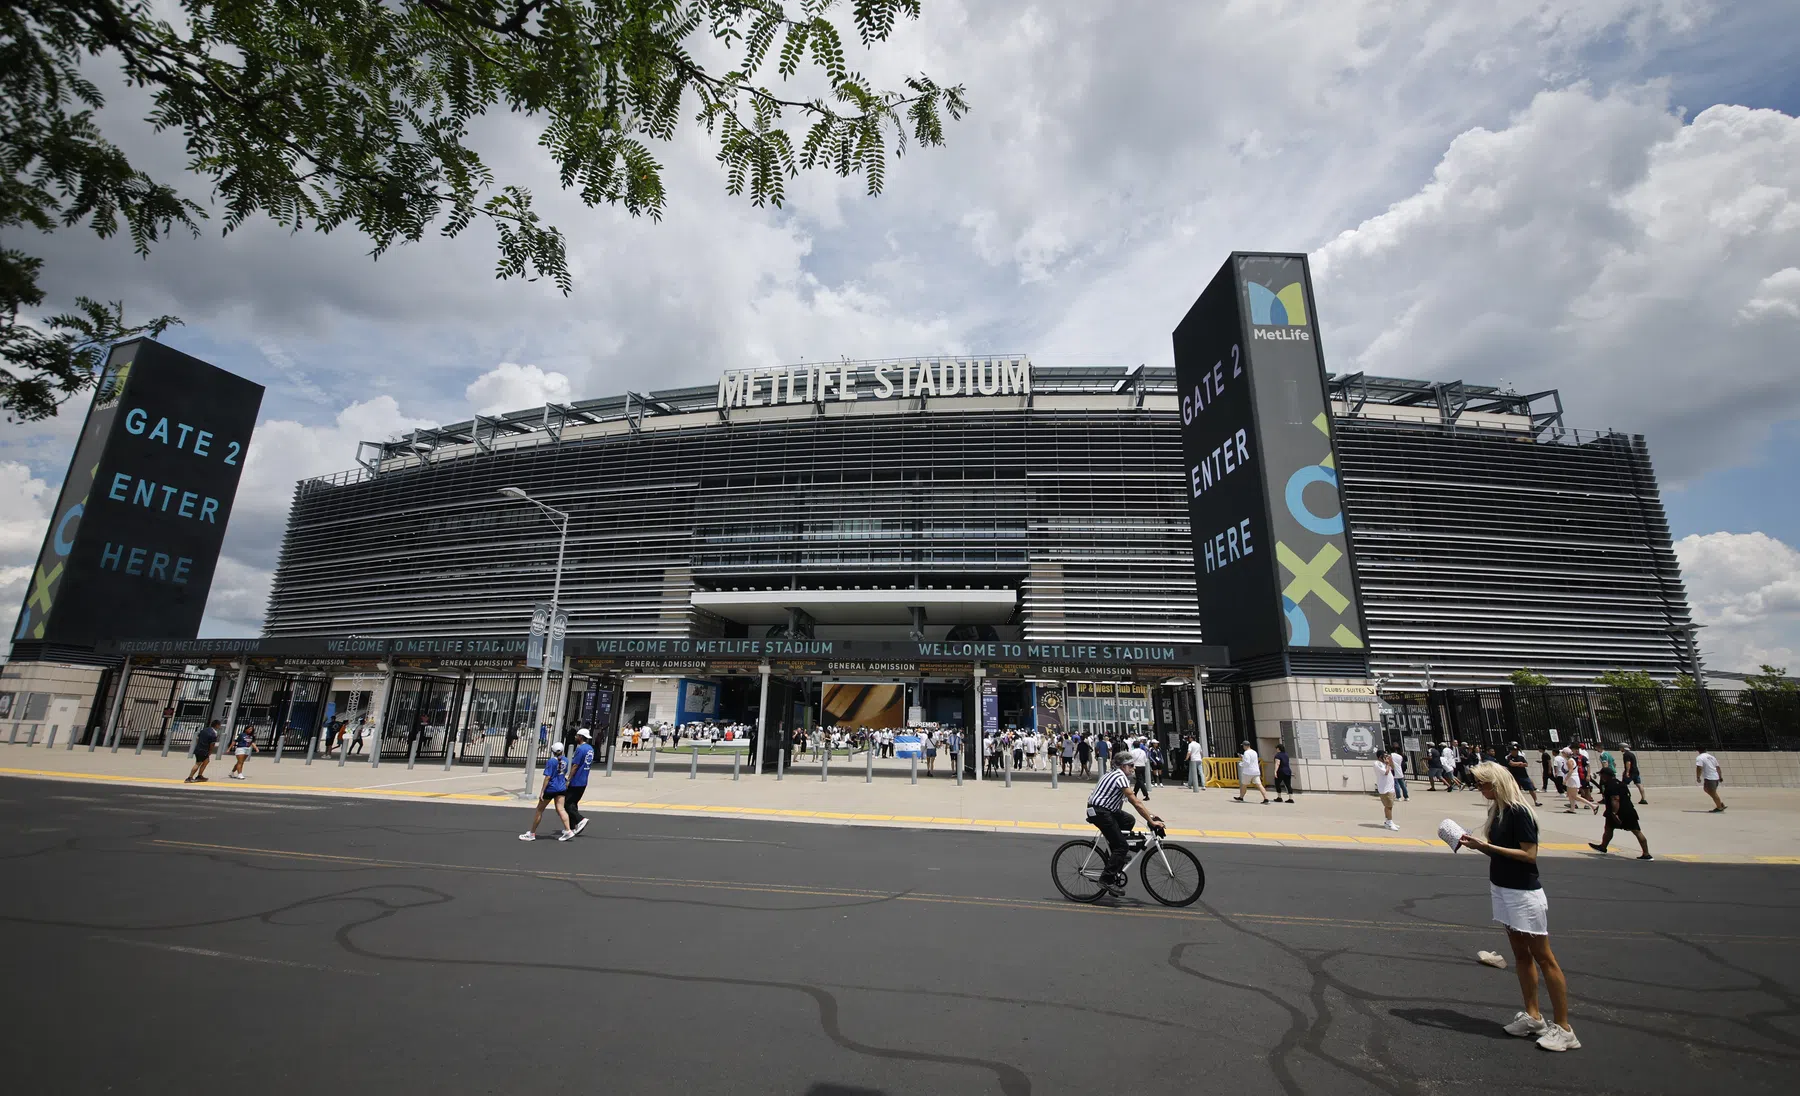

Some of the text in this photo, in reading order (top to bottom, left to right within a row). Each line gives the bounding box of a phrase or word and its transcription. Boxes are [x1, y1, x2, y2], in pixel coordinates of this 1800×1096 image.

[1253, 328, 1309, 340] MetLife
[717, 357, 1030, 408] METLIFE STADIUM
[1182, 343, 1242, 426] GATE 2
[125, 408, 240, 466] GATE 2
[1191, 428, 1250, 499] ENTER
[108, 472, 219, 524] ENTER
[1204, 517, 1254, 574] HERE
[100, 542, 193, 585] HERE
[120, 640, 260, 652] WELCOME TO METLIFE STADIUM
[328, 641, 385, 652] WELCOME
[407, 641, 463, 652] METLIFE
[596, 641, 833, 654] WELCOME TO METLIFE STADIUM
[918, 643, 1175, 660] WELCOME TO METLIFE STADIUM
[625, 660, 706, 668] GENERAL ADMISSION
[828, 662, 915, 671] GENERAL ADMISSION
[1041, 666, 1132, 675] GENERAL ADMISSION
